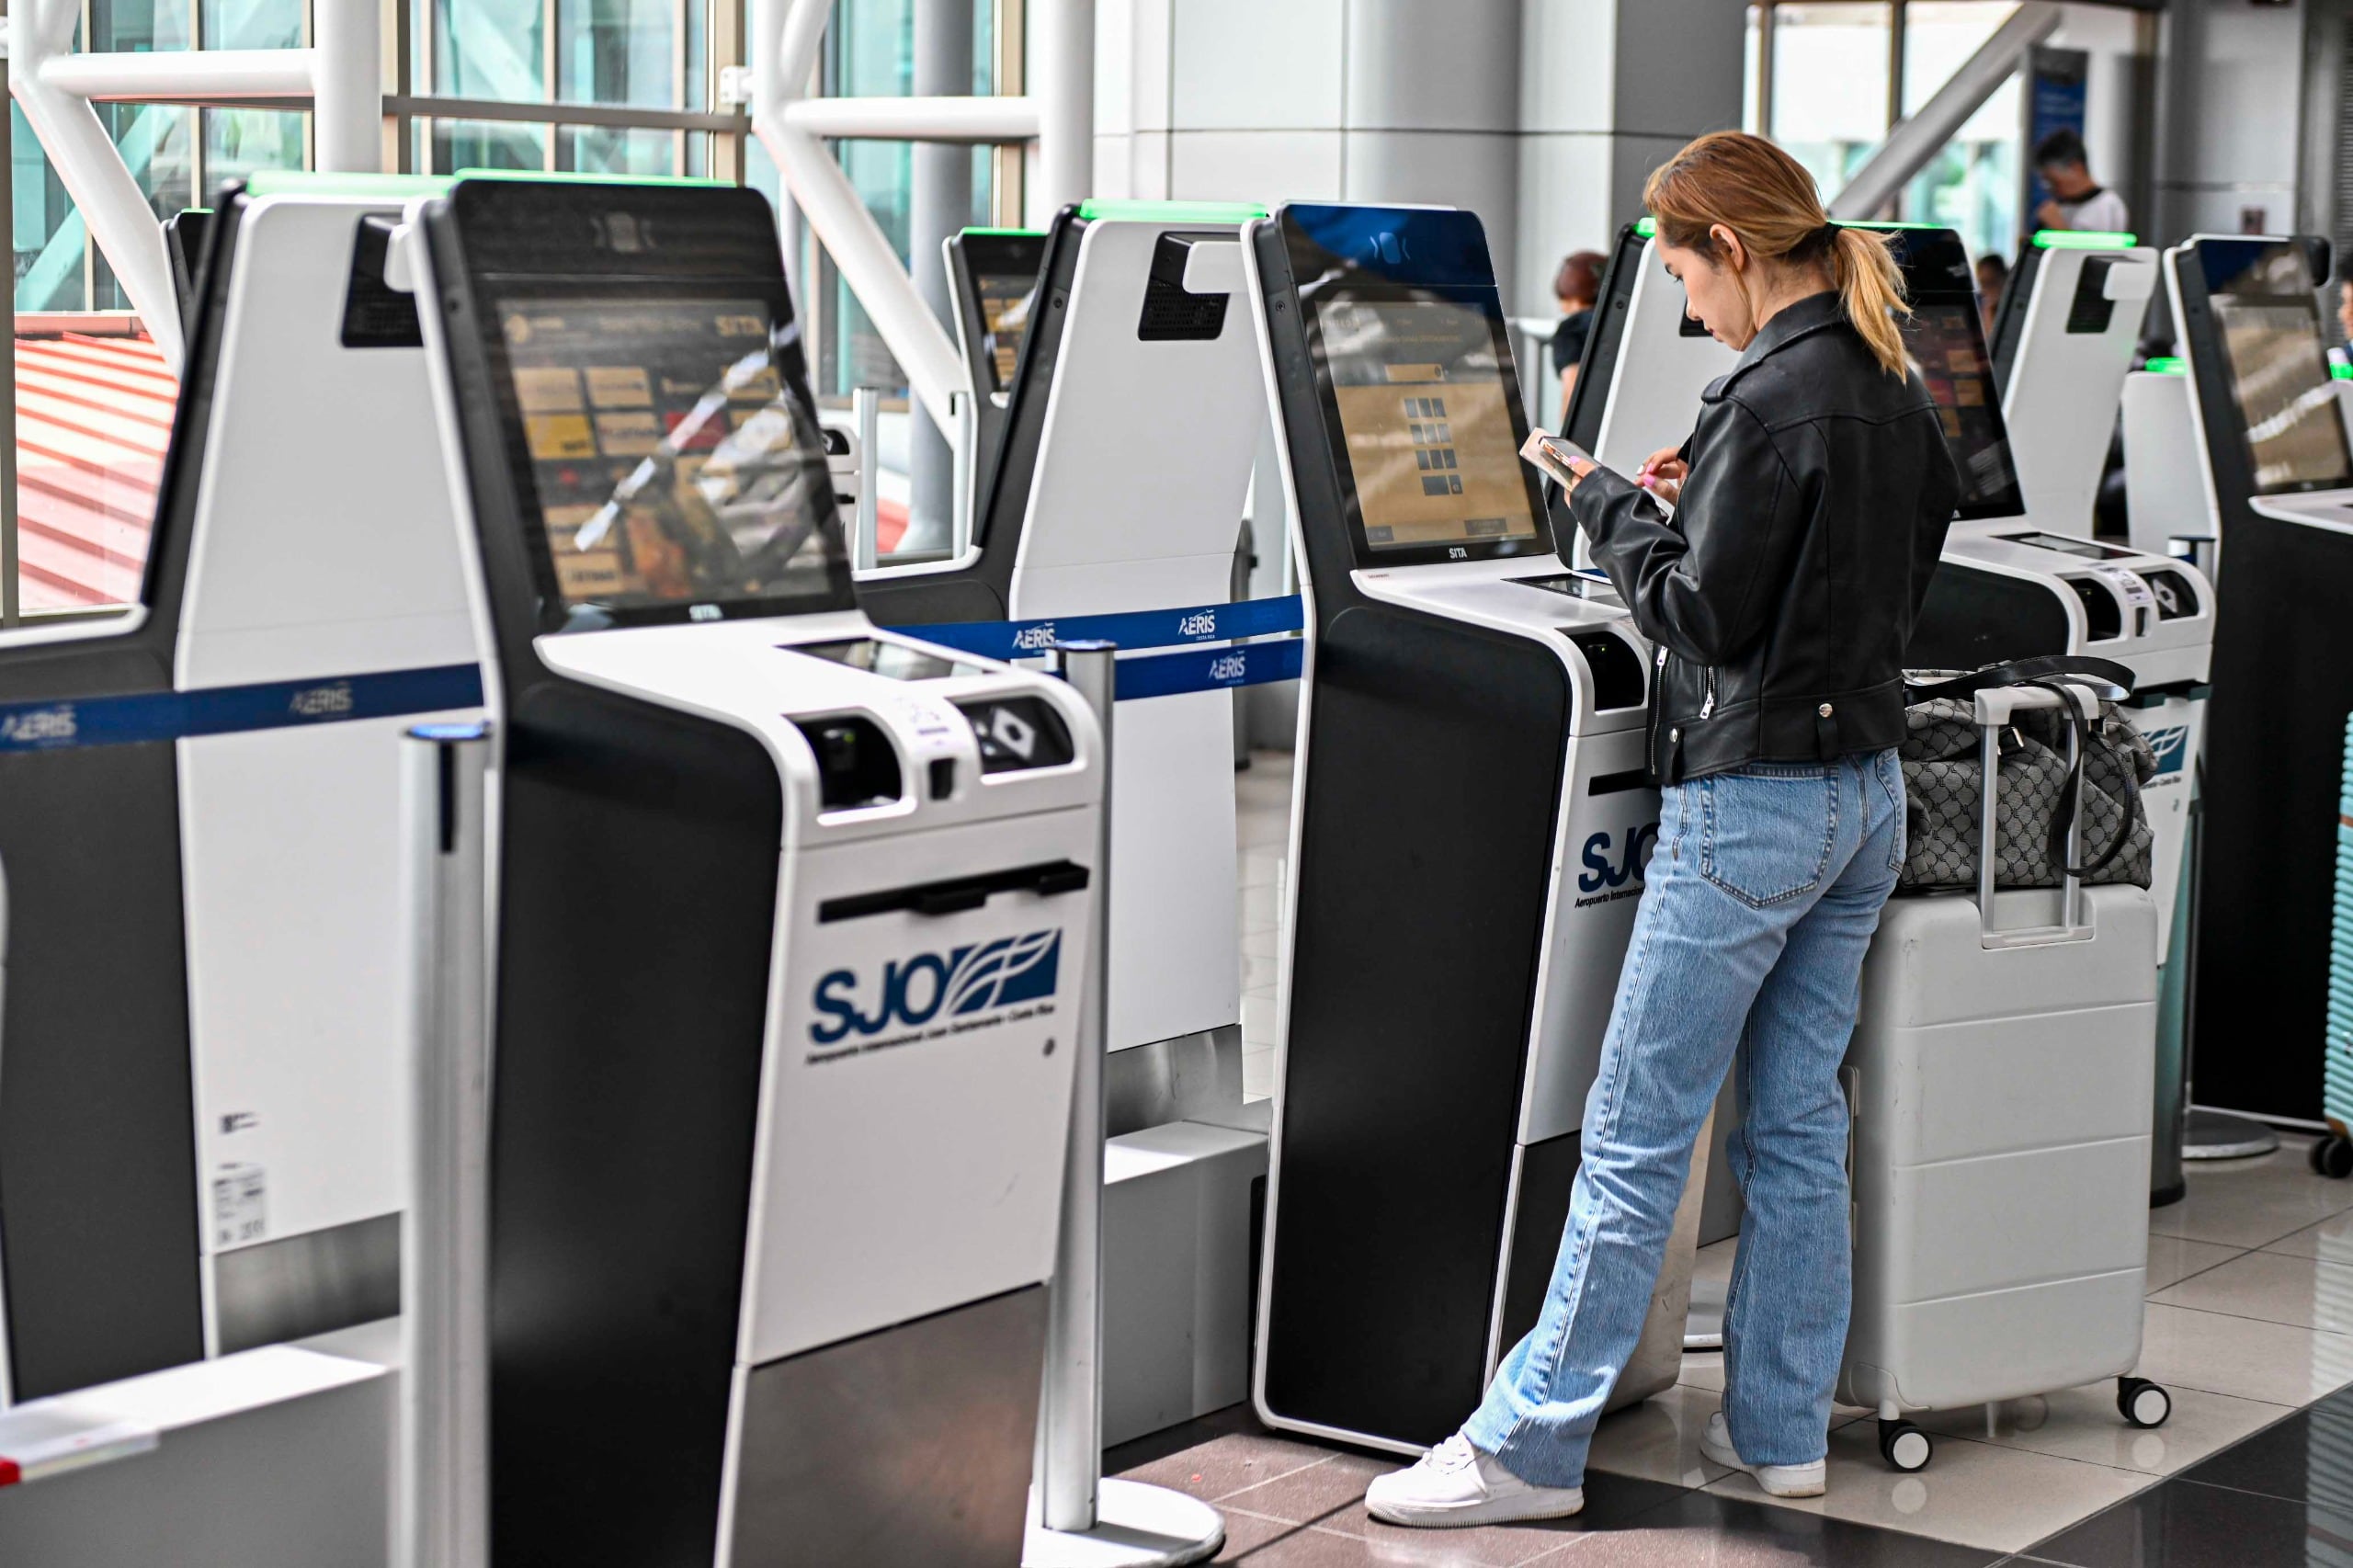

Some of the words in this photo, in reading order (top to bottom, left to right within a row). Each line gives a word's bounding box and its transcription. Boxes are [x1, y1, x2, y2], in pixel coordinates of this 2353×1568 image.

[1449, 547, 1468, 559] SITA
[1177, 614, 1216, 636] AERIS
[1012, 627, 1056, 649] AERIS
[1575, 893, 1609, 908] Aeropuerto
[1610, 886, 1644, 900] Internacion
[810, 953, 948, 1044] SJO
